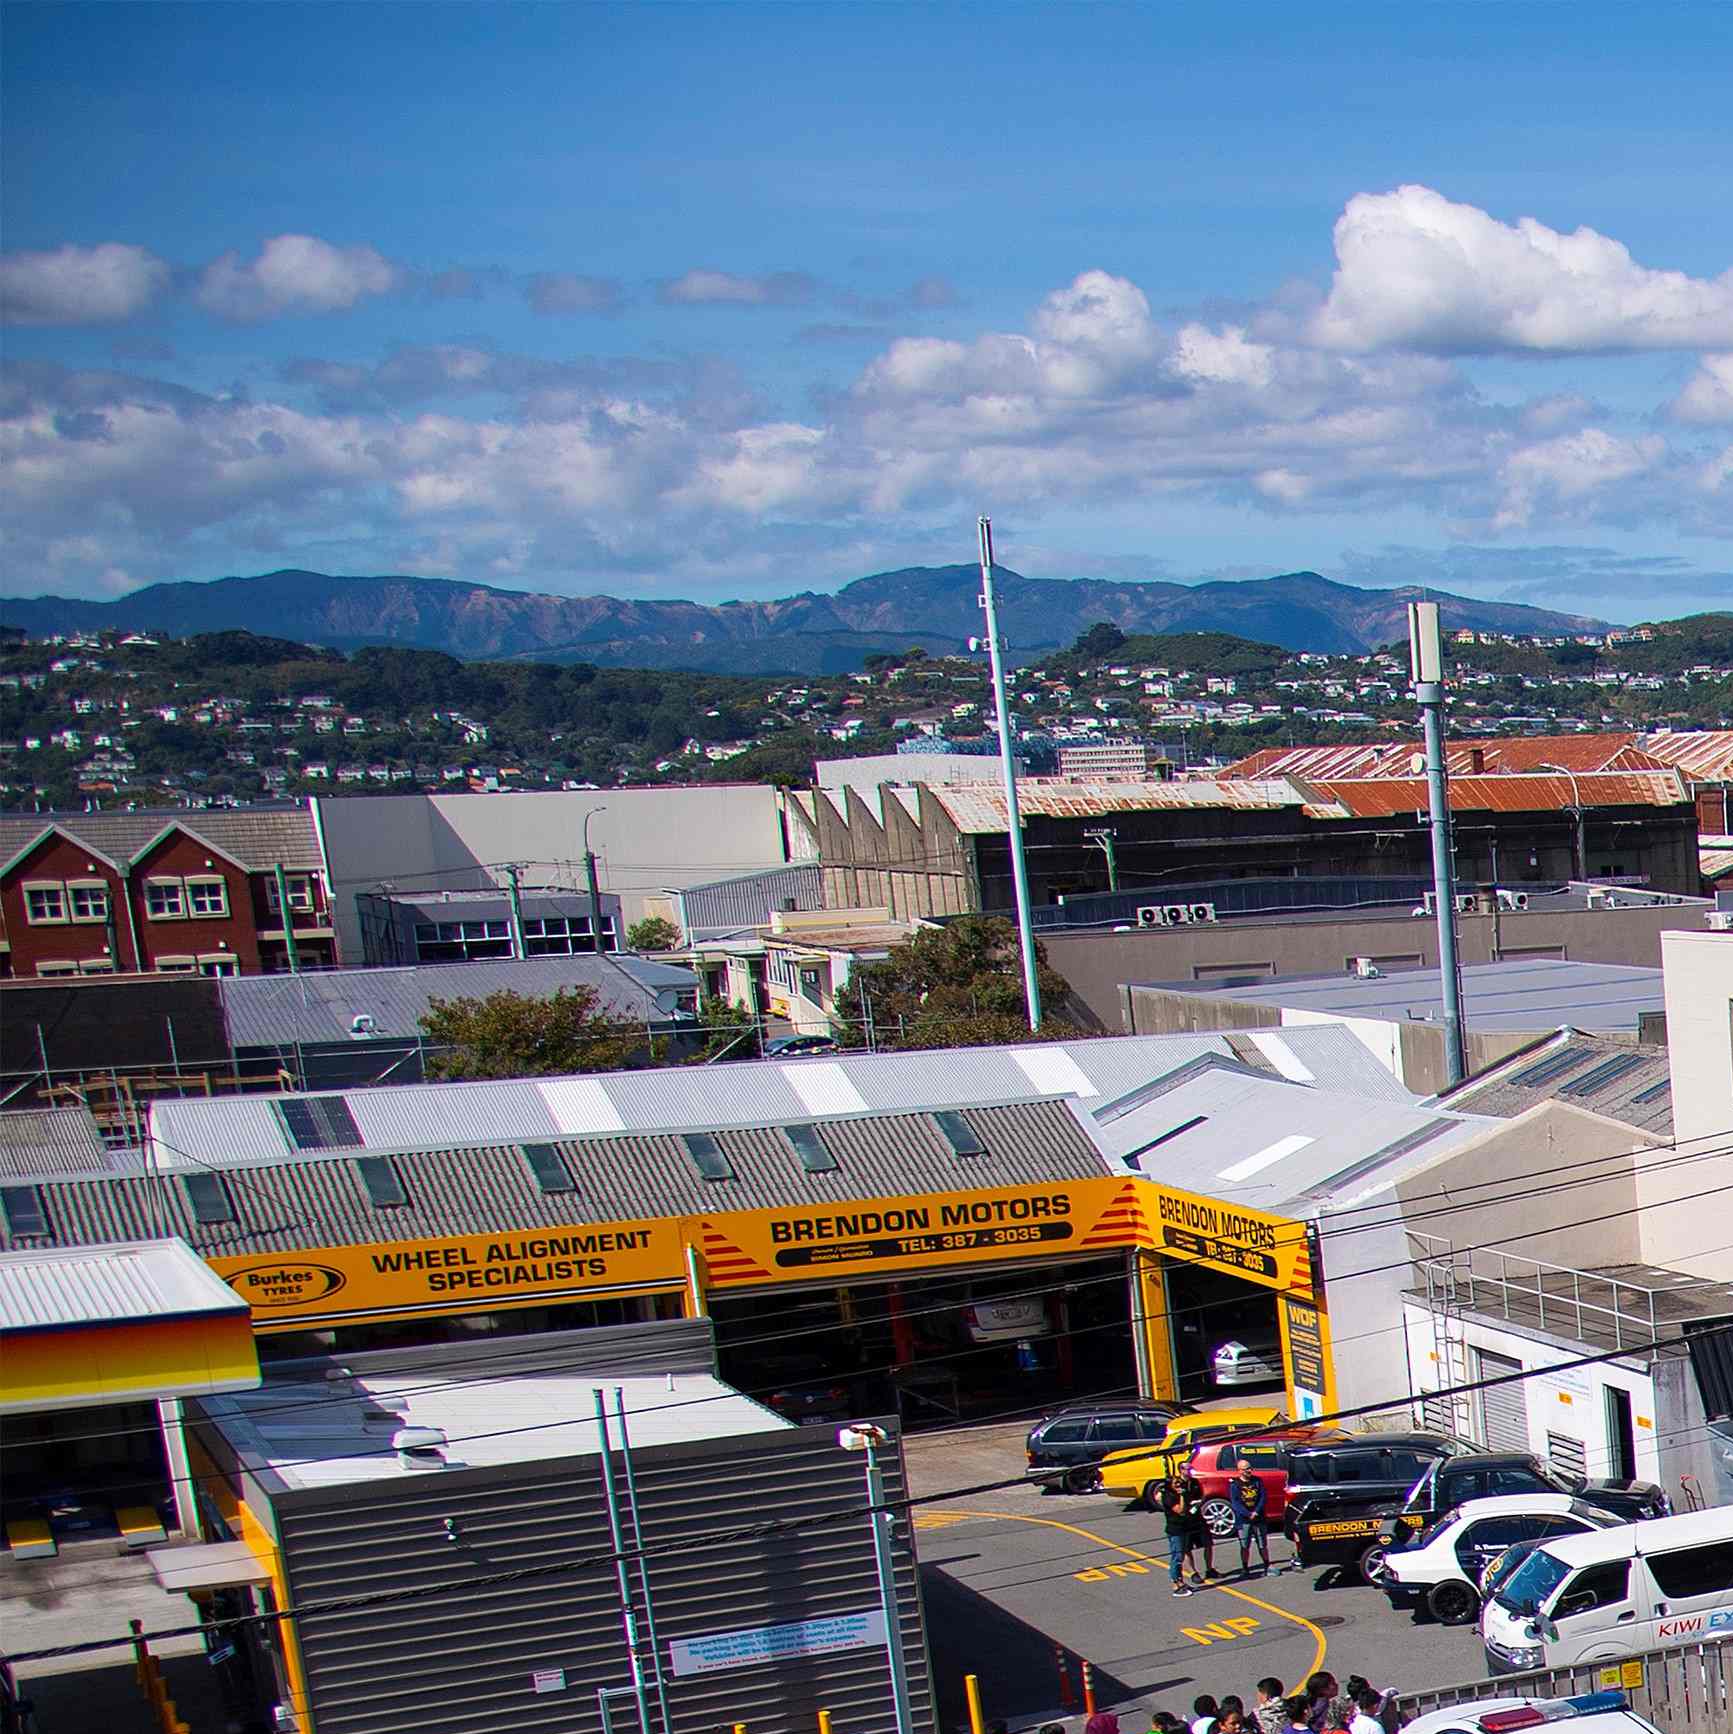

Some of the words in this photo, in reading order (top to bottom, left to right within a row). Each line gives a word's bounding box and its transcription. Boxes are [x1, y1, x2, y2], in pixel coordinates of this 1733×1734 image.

[770, 1207, 929, 1244] BRENDON
[941, 1194, 1072, 1227] MOTORS
[1158, 1194, 1218, 1234] BRENDON
[1221, 1212, 1275, 1250] MOTORS
[372, 1247, 477, 1273] WHEEL
[486, 1230, 652, 1263] ALIGNMENT
[897, 1238, 936, 1253] TEL:
[942, 1232, 977, 1248] 387
[994, 1226, 1042, 1243] 3035
[248, 1270, 313, 1287] Burkes
[428, 1258, 607, 1292] SPECIALISTS
[263, 1284, 304, 1297] TYRES
[1288, 1304, 1317, 1328] WOF
[1309, 1520, 1368, 1536] BRENDON
[1179, 1616, 1261, 1646] NP
[1659, 1617, 1704, 1637] KIWI
